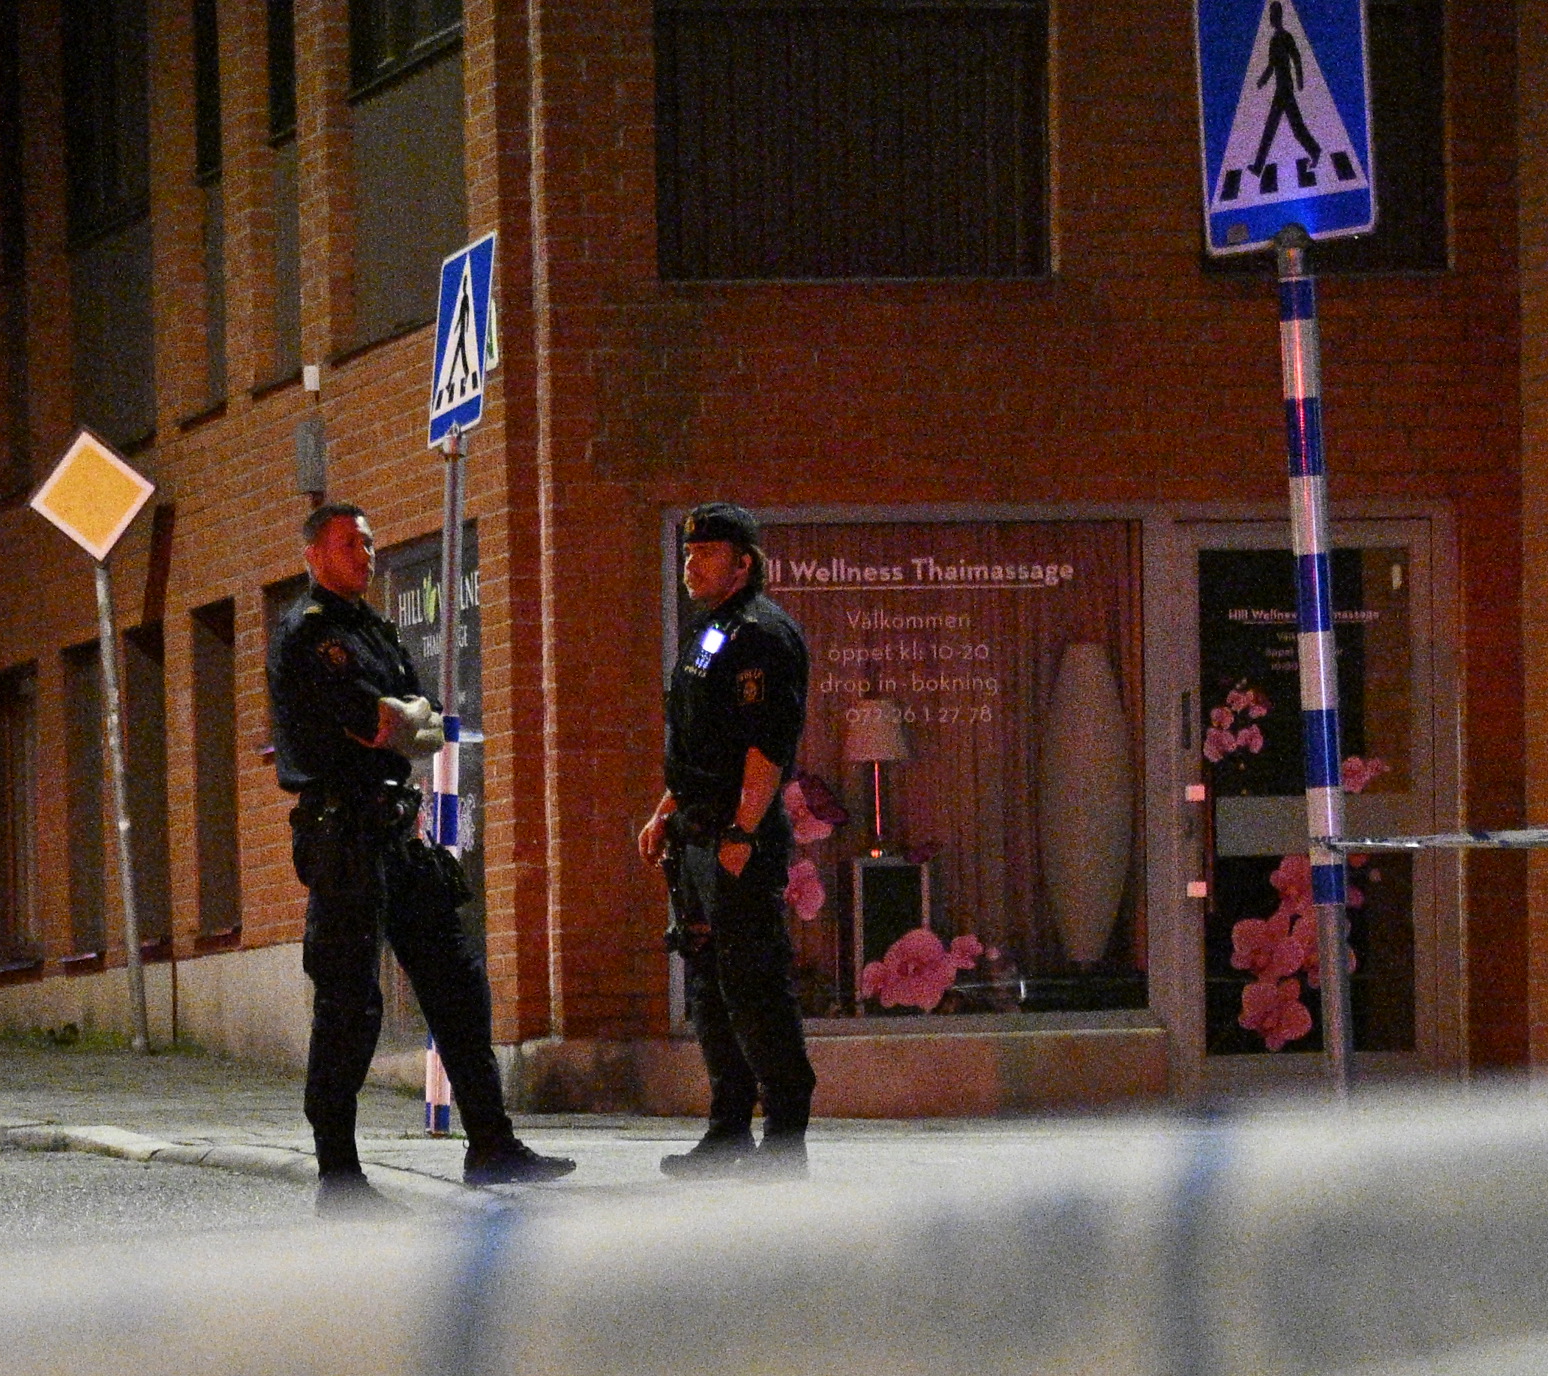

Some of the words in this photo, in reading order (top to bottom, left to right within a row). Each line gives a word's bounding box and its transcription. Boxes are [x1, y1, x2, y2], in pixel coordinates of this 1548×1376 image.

[789, 558, 903, 582] Wellness
[911, 557, 1075, 586] Thaimassage
[398, 588, 424, 628] HILL
[846, 609, 971, 630] Välkommen
[1228, 608, 1248, 620] Hill
[1251, 608, 1298, 620] Wellnes
[828, 642, 893, 667] öppet
[932, 643, 989, 661] 10-20
[820, 672, 871, 697] drop
[878, 673, 897, 692] in
[912, 670, 998, 696] bokning
